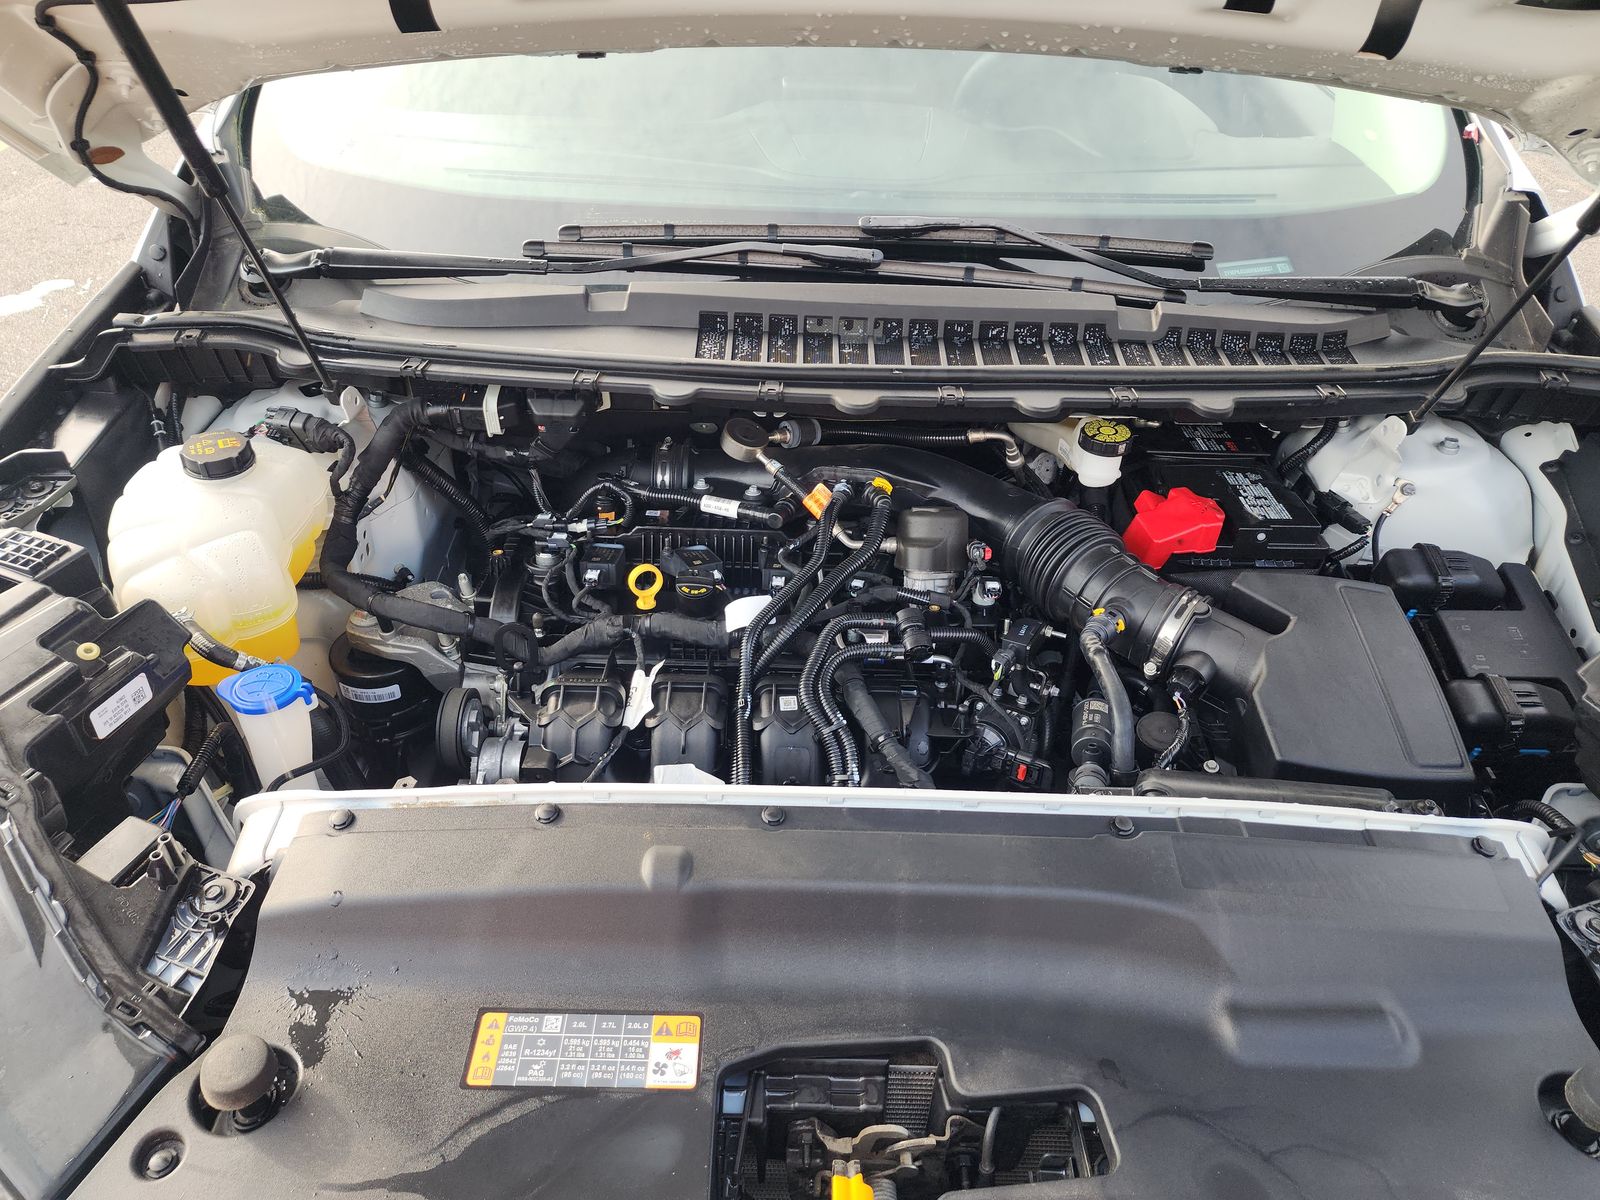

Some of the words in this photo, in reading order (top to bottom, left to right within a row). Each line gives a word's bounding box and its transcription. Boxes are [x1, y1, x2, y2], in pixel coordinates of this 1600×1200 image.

[508, 1015, 540, 1023] FoMoCo
[505, 1024, 528, 1033] (GWP
[582, 1038, 590, 1047] kg
[611, 1039, 620, 1048] kg
[623, 1039, 641, 1047] 0.454
[641, 1040, 649, 1049] kg
[524, 1048, 557, 1058] R-1234yf
[528, 1069, 545, 1077] PAG
